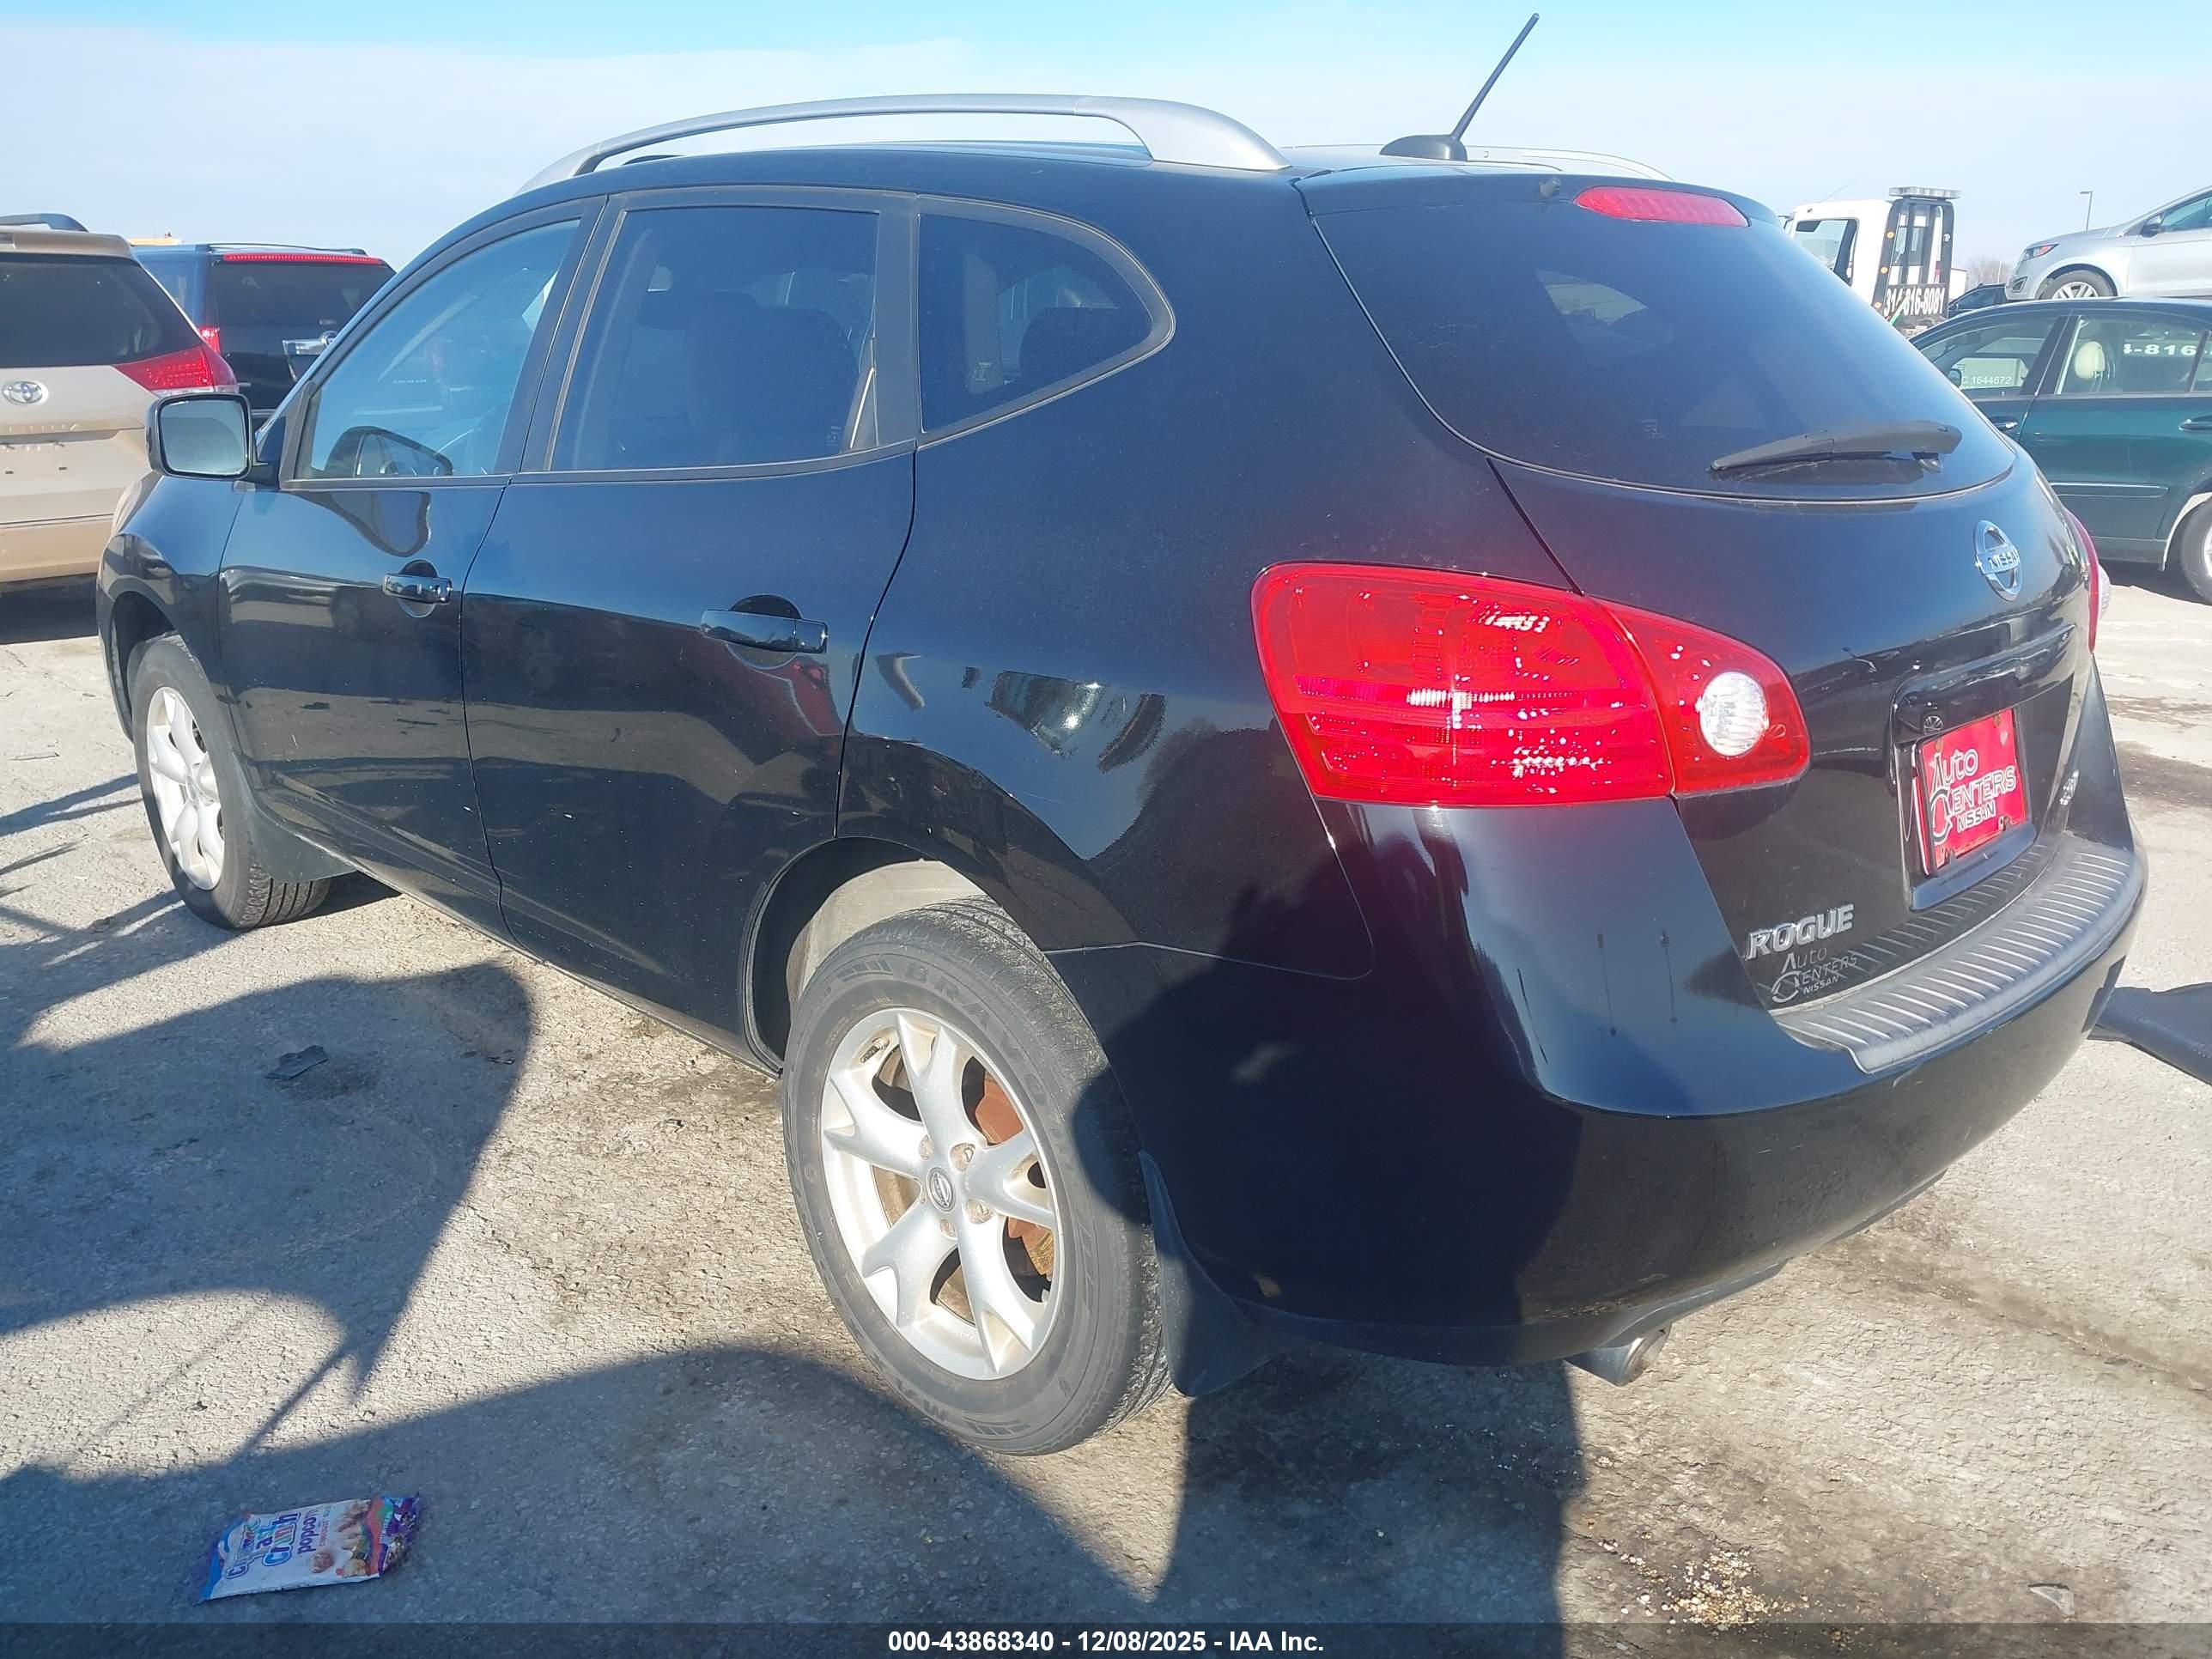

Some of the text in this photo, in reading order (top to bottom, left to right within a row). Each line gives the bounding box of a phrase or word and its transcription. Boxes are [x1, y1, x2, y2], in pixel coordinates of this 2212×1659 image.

[1883, 287, 1946, 317] 31816-8081
[1972, 376, 2012, 385] 1644672
[1931, 748, 1979, 799] Auto
[1930, 765, 2017, 845] CENTERS
[1956, 799, 1996, 834] NISSAN
[1744, 902, 1855, 961] ROGUE
[1771, 953, 1858, 1004] CENTERS
[1781, 947, 1827, 975] Auto
[1803, 975, 1840, 996] NISSAN
